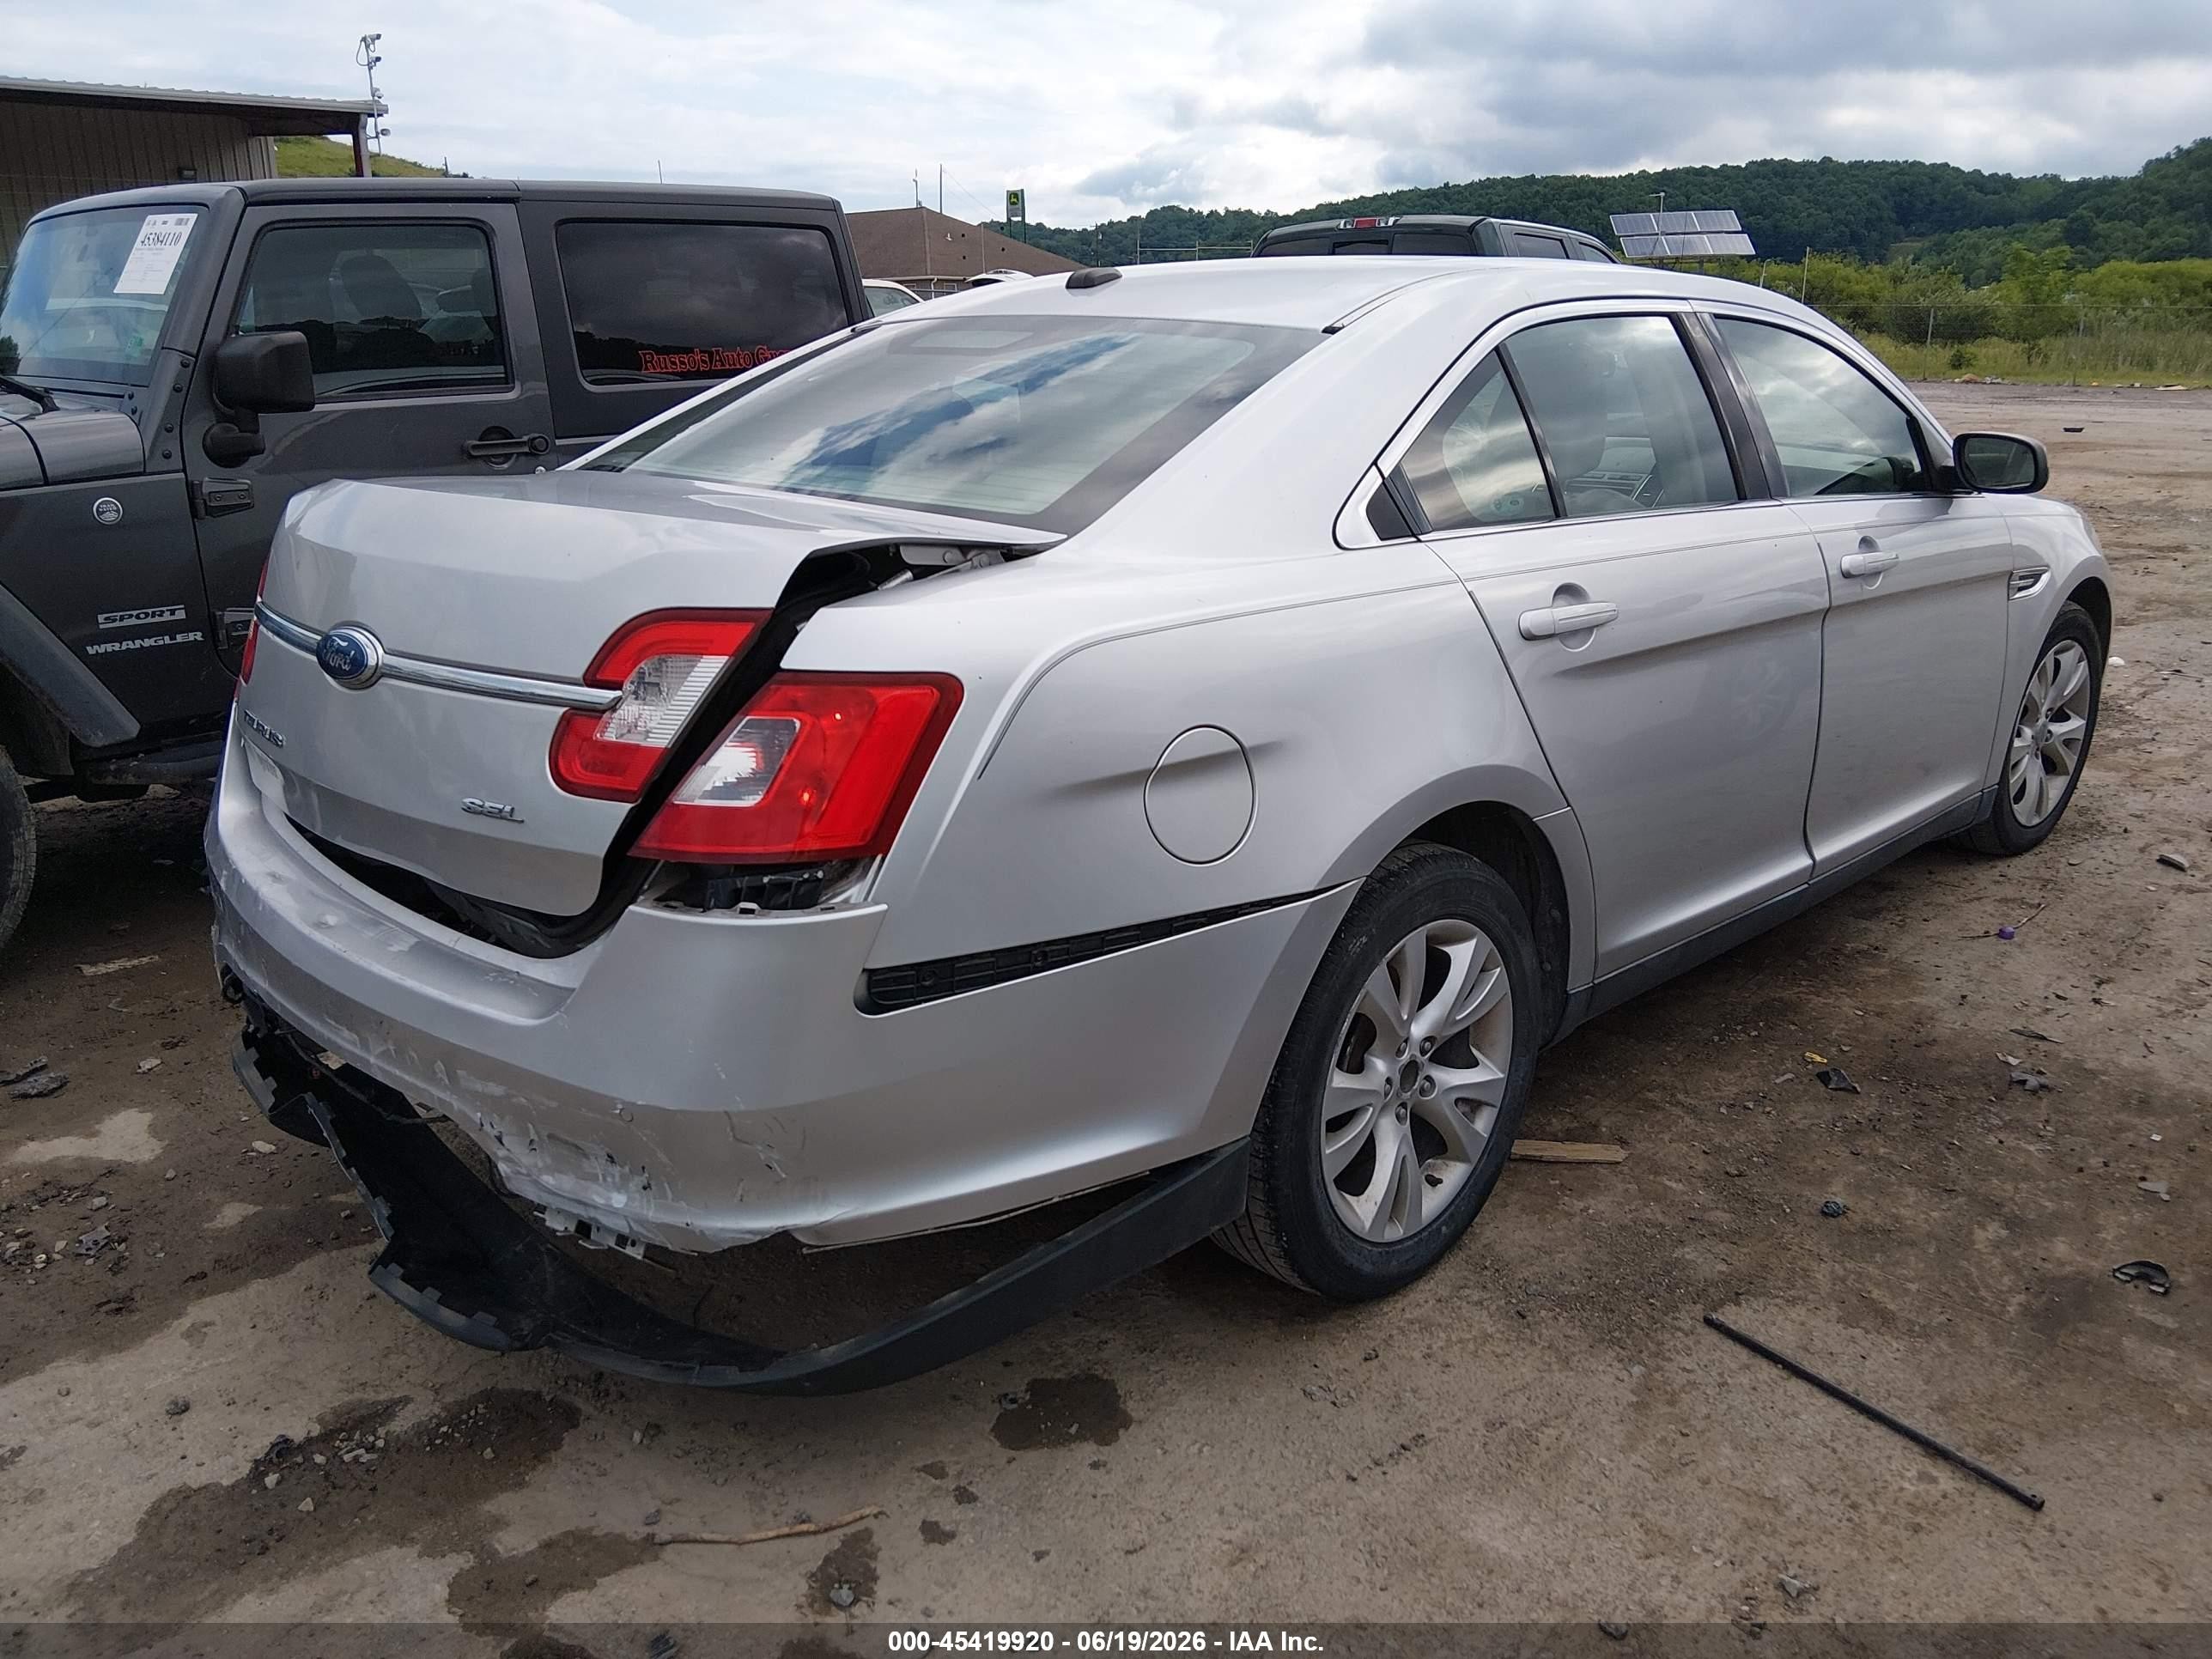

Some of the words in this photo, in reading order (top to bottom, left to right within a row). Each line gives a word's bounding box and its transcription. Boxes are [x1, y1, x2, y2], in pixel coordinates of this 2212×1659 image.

[140, 231, 183, 247] 45384110
[639, 348, 710, 373] Russo's
[712, 346, 753, 370] Auto
[103, 607, 186, 624] SPORT
[86, 631, 204, 655] WRANGLER
[460, 797, 525, 823] SEL
